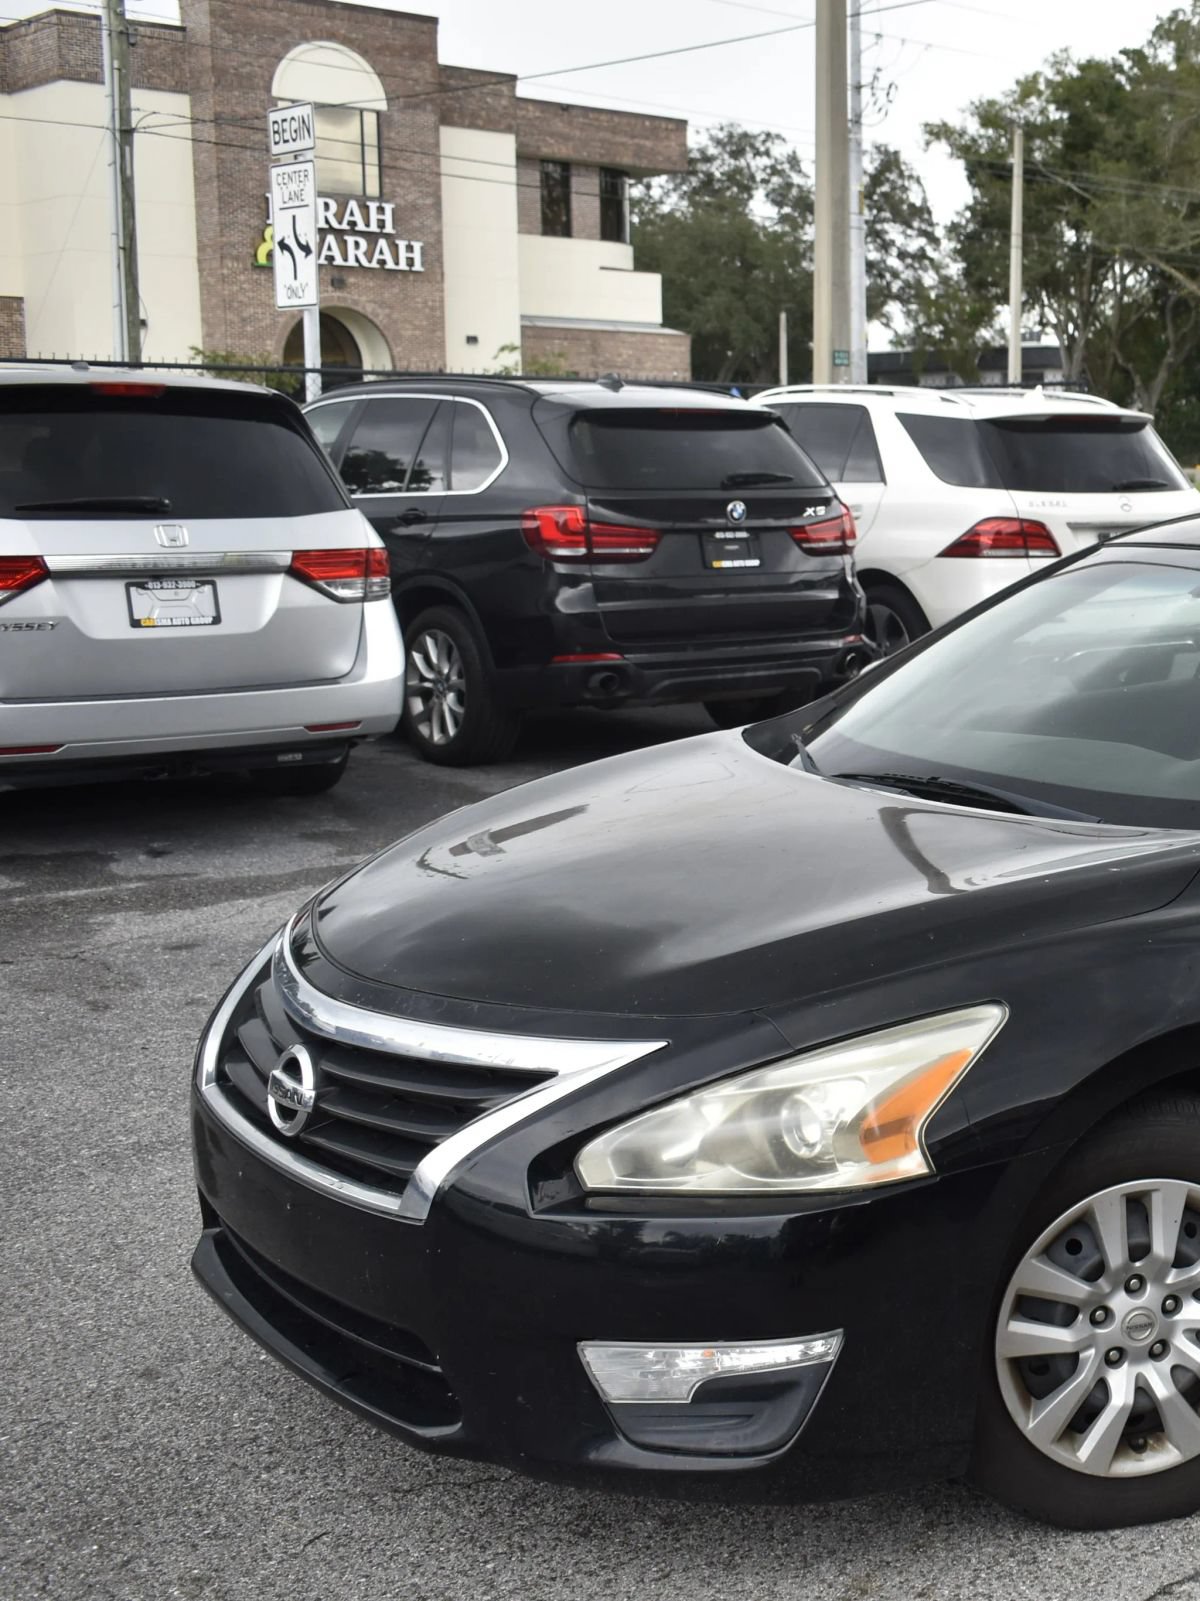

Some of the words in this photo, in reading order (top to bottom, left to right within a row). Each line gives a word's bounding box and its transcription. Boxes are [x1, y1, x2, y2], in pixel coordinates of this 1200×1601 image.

[272, 113, 312, 146] BEGIN
[276, 168, 309, 187] CENTER
[282, 188, 305, 205] LANE
[317, 234, 425, 272] ARAH
[803, 506, 826, 517] X5
